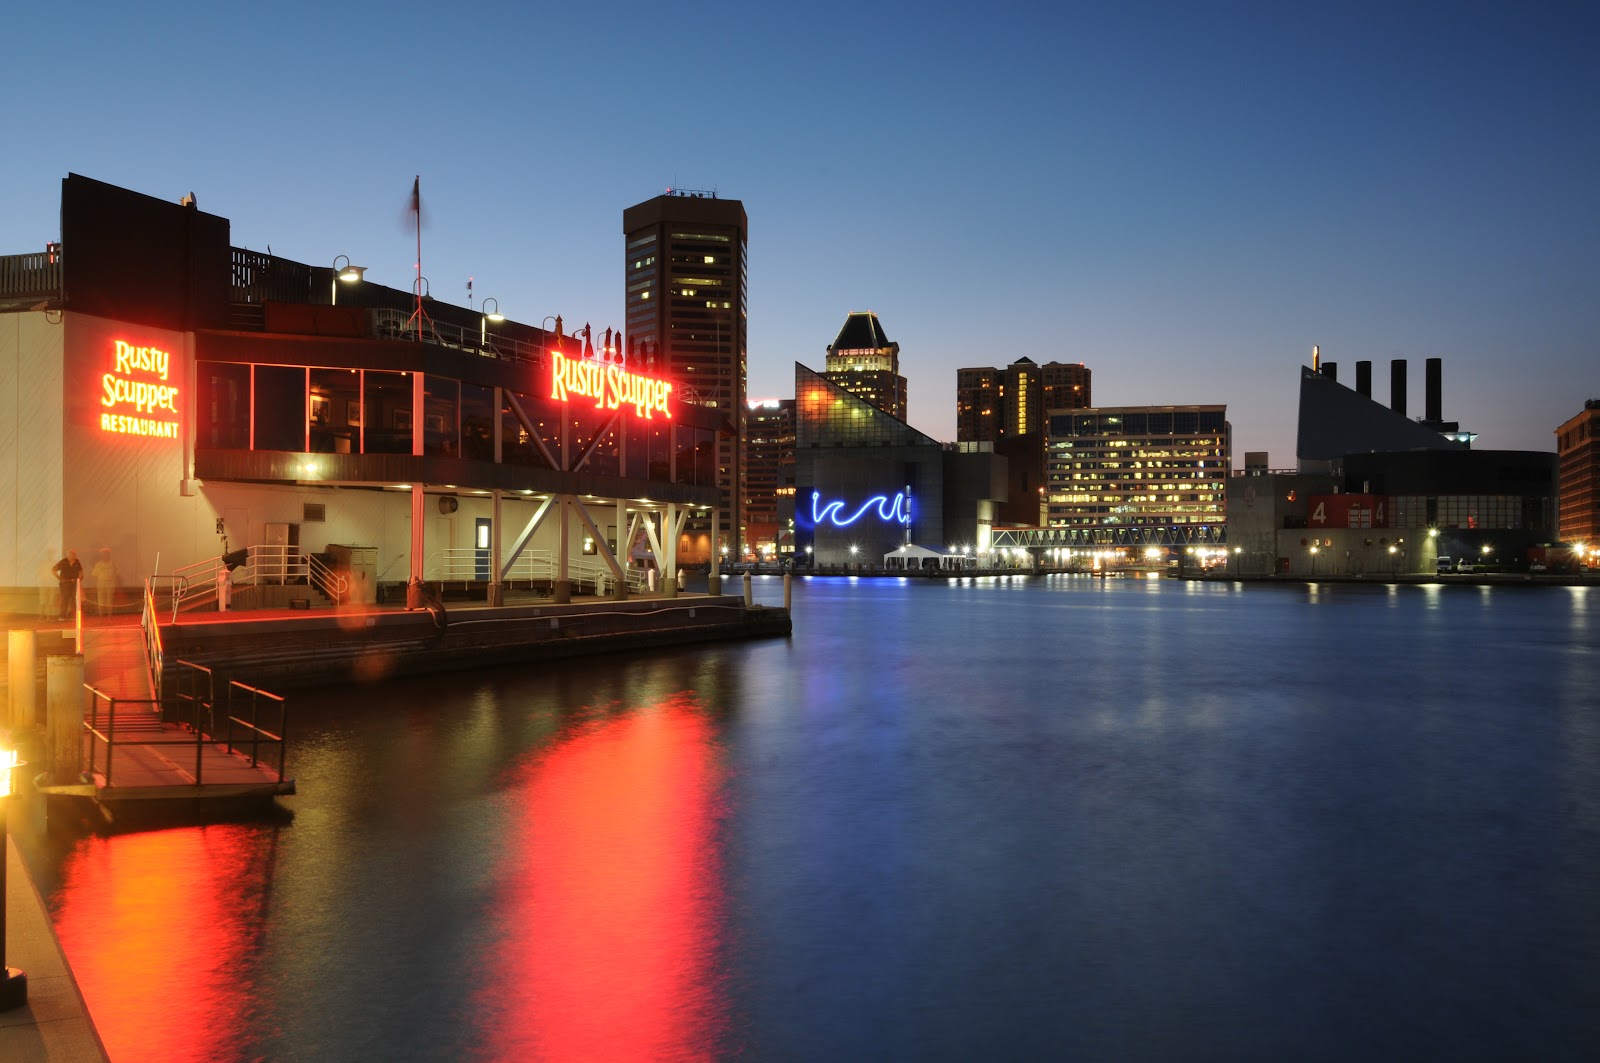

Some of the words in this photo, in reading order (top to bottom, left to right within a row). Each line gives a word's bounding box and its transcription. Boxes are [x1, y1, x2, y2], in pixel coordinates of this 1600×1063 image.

[114, 340, 169, 380] Rusty
[101, 373, 179, 414] Scupper
[550, 350, 605, 409] Rusty
[607, 364, 673, 419] Scupper
[101, 413, 179, 439] RESTAURANT
[1312, 501, 1327, 524] 4
[1375, 501, 1384, 524] 4
